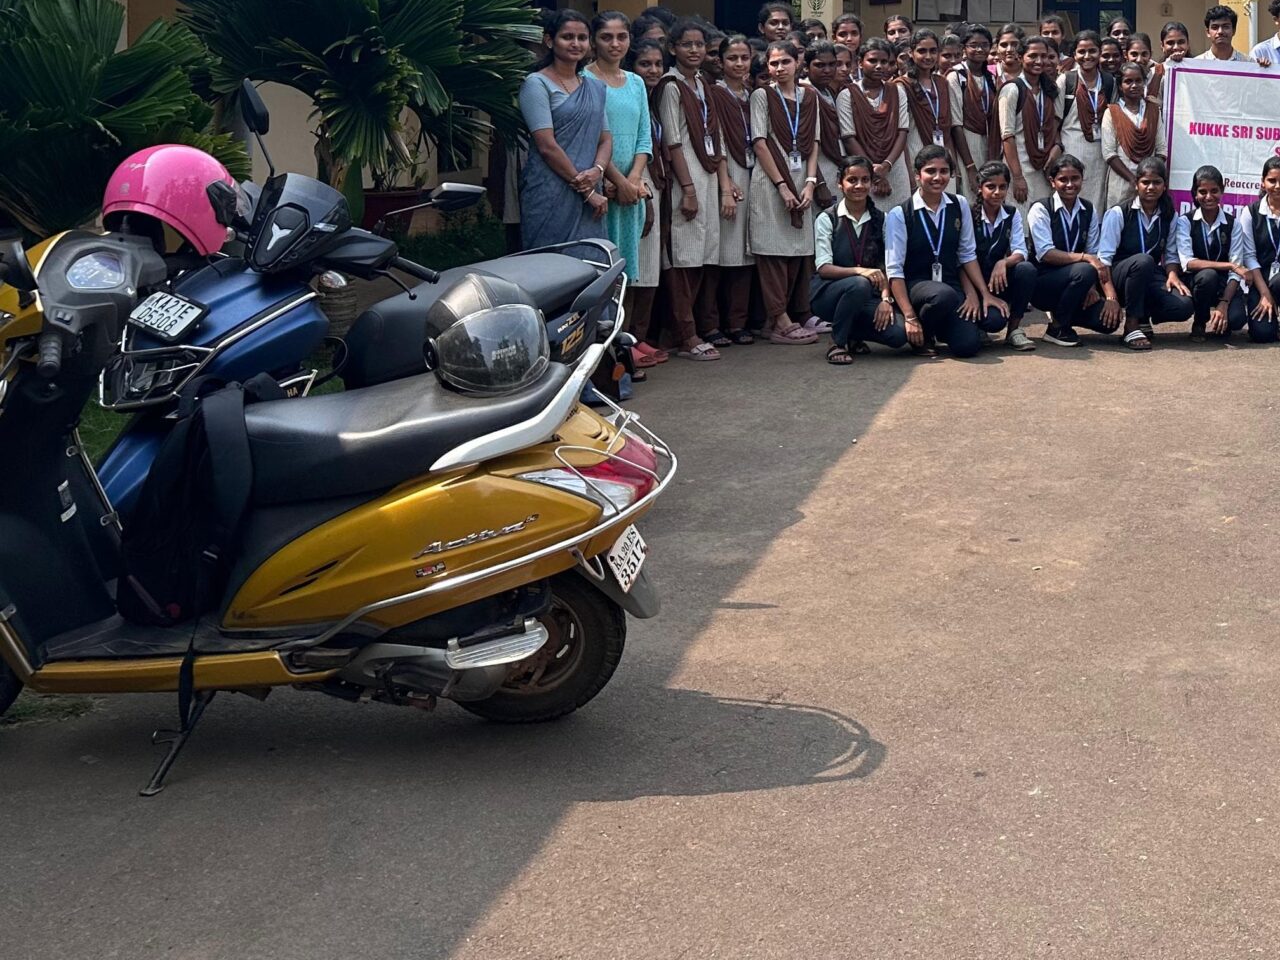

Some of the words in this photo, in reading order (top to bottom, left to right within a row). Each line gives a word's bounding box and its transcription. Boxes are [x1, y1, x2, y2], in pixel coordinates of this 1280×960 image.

[1189, 122, 1229, 138] KUKKE
[1232, 125, 1253, 139] SRI
[137, 306, 178, 332] D5308
[151, 293, 195, 320] KA21E
[561, 321, 585, 355] 125
[621, 538, 644, 586] 3517
